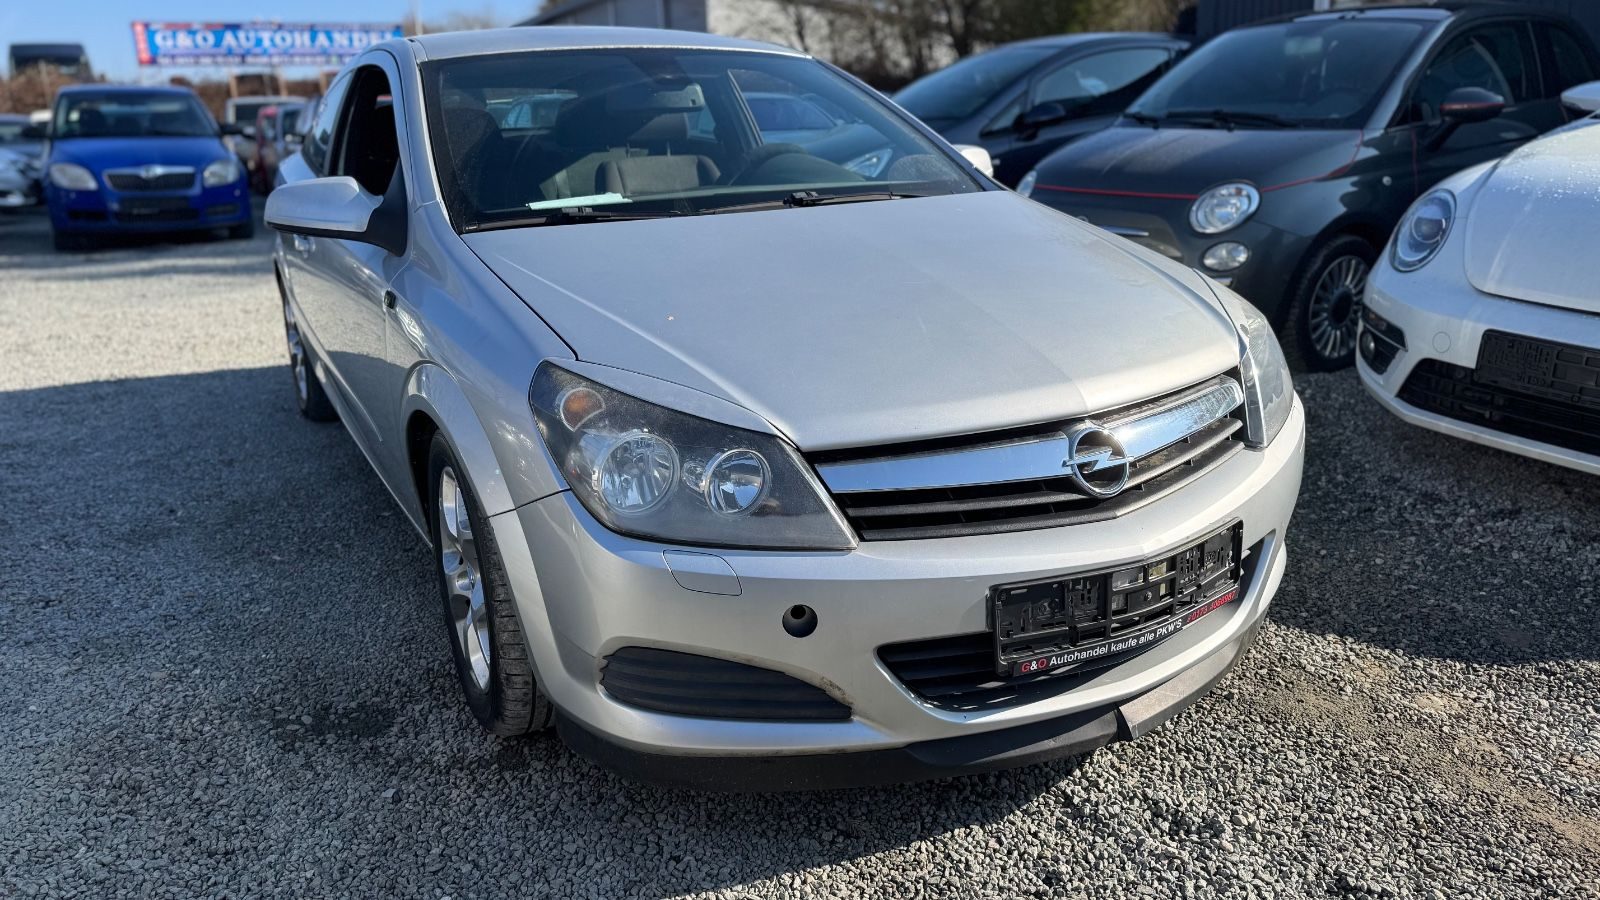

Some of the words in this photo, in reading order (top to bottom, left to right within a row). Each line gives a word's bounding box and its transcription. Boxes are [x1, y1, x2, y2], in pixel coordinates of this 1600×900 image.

[154, 30, 215, 49] G&O
[1021, 658, 1047, 672] G&O
[1049, 646, 1108, 666] Autohandel
[1111, 635, 1137, 653] kaufe
[1139, 631, 1155, 644] alle
[1156, 619, 1182, 638] PKW'S
